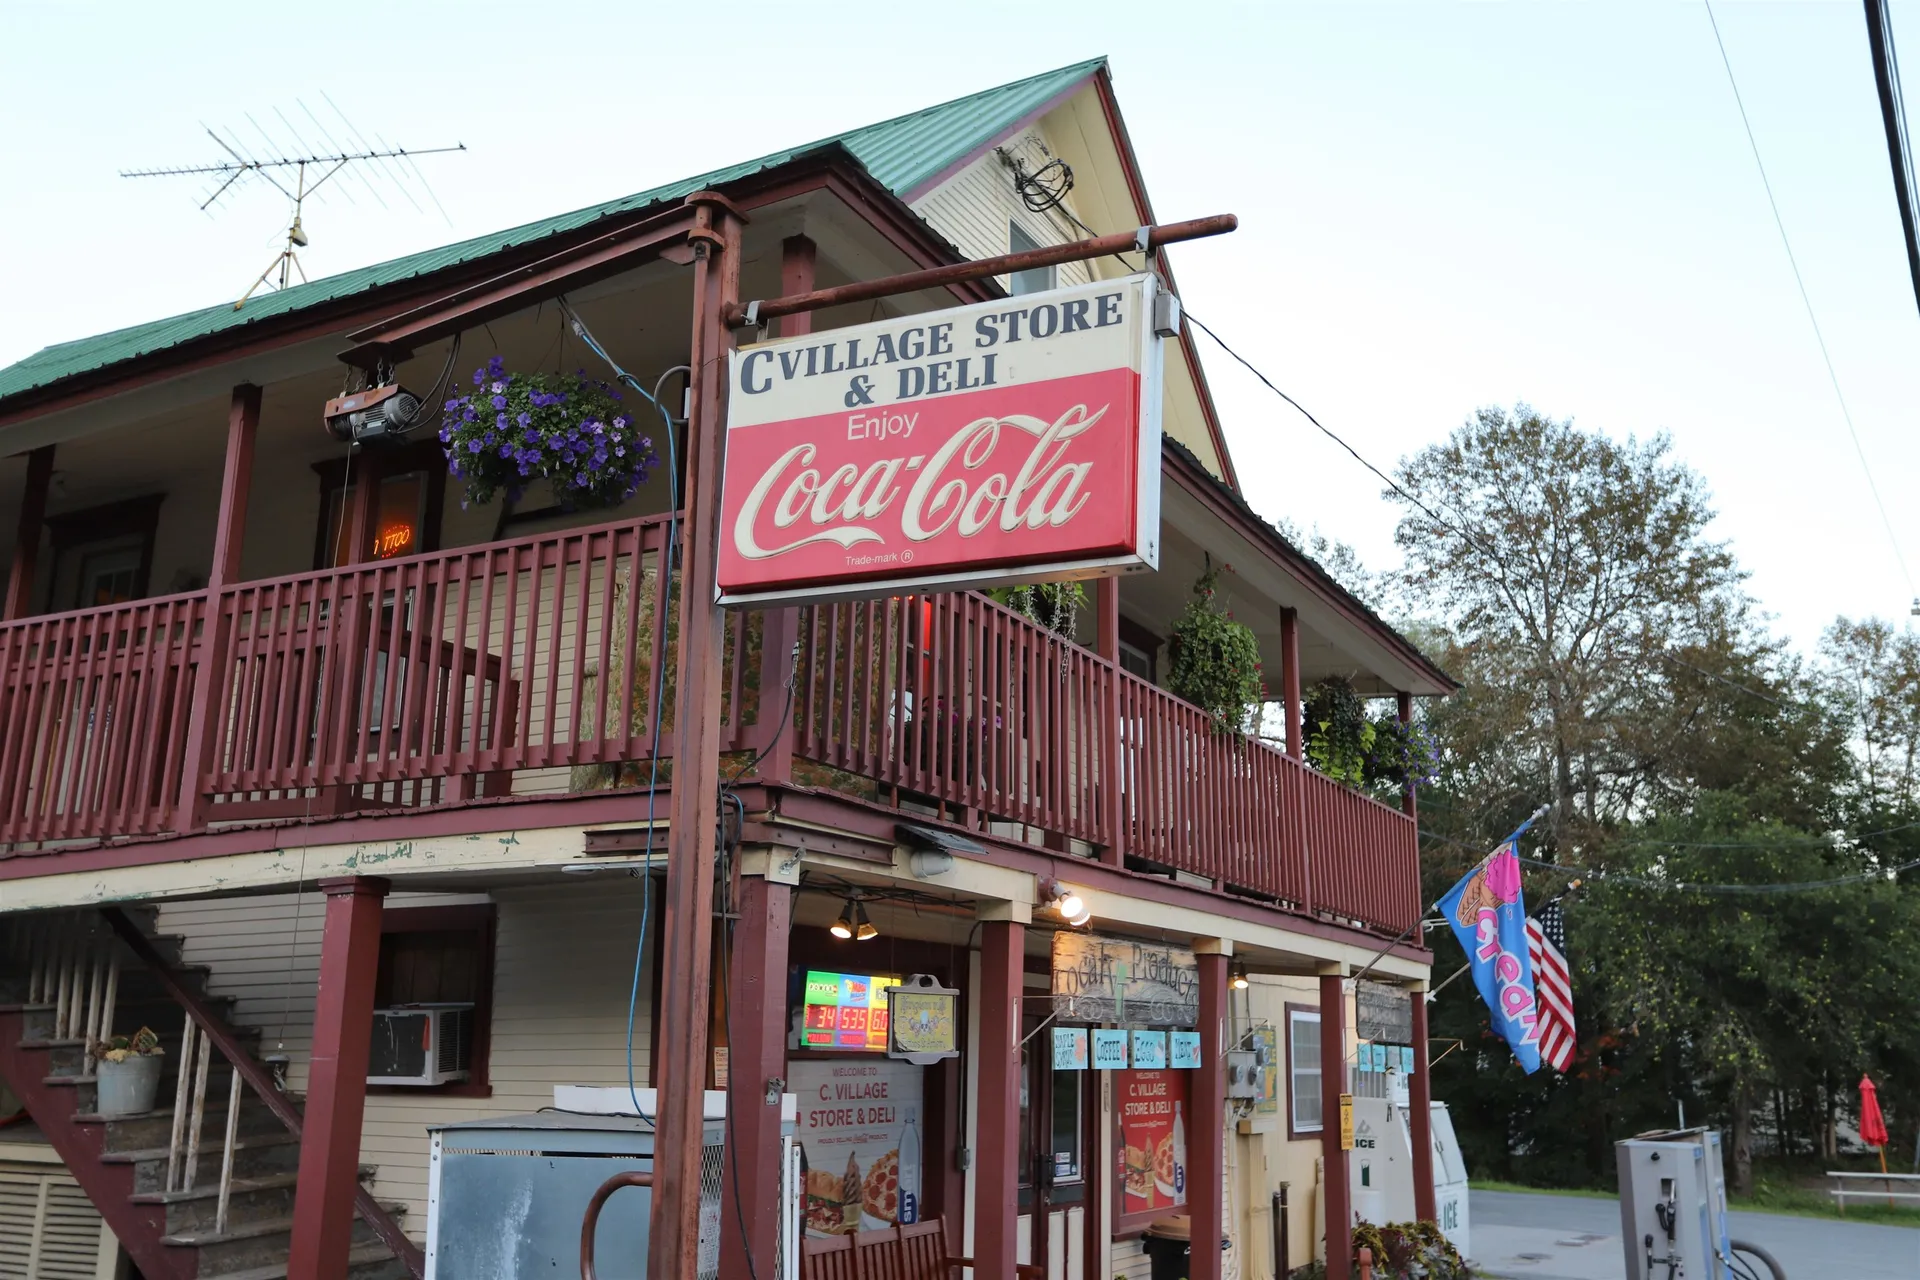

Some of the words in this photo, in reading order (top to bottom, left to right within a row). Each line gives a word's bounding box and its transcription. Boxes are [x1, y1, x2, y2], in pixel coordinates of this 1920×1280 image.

[975, 292, 1124, 348] STORE
[843, 374, 875, 408] &
[896, 353, 998, 400] DELI
[847, 411, 919, 441] Enjoy
[734, 403, 1110, 560] Coca-Cola
[845, 552, 898, 567] Trade-mark
[817, 1006, 835, 1028] 34
[841, 1008, 867, 1030] 535
[832, 1067, 867, 1077] WELCOME
[868, 1066, 878, 1076] TO
[819, 1083, 832, 1101] C.
[835, 1082, 888, 1100] VILLAGE
[1137, 1083, 1167, 1096] VILLAGE
[809, 1108, 854, 1128] STORE
[856, 1107, 865, 1125] &
[868, 1106, 896, 1124] DELI
[1125, 1102, 1148, 1116] STORE
[1149, 1102, 1155, 1114] &
[1155, 1101, 1171, 1114] DELI
[1355, 1138, 1375, 1149] ICE
[1443, 1199, 1458, 1231] ICE
